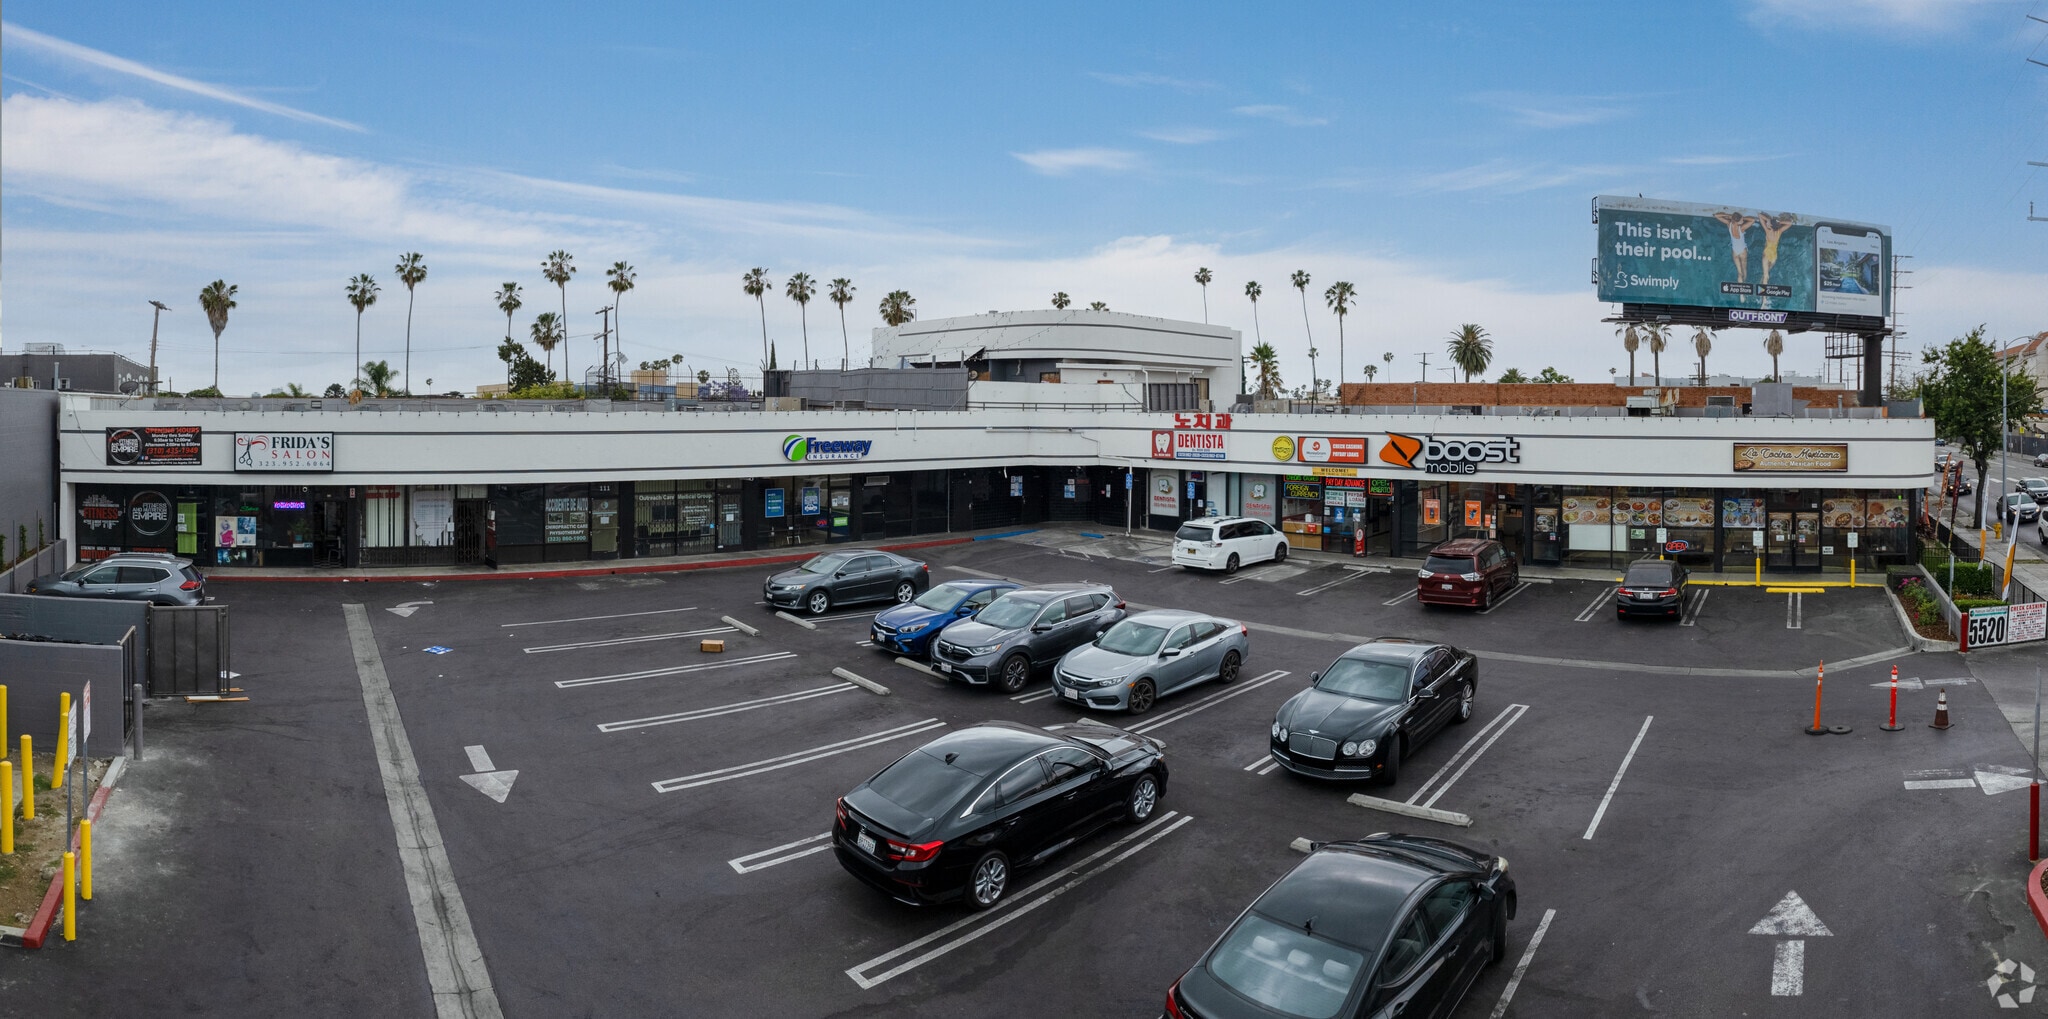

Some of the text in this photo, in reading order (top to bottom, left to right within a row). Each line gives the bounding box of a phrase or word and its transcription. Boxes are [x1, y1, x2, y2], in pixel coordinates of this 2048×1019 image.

[1615, 222, 1692, 240] This isn't
[1615, 242, 1712, 262] their pool...
[1630, 274, 1679, 290] Swimply
[1732, 311, 1783, 322] OUTFRONT
[1174, 413, 1232, 430] 노치과
[272, 436, 330, 449] FRIDA'S
[807, 437, 872, 455] Freeway
[1178, 434, 1224, 448] DENTISTA
[272, 450, 330, 459] SALON
[1425, 436, 1519, 462] boost
[1742, 448, 1840, 459] La Cocina Mexicana
[1426, 462, 1475, 473] mobile
[1345, 479, 1365, 487] ADVANCE
[1290, 490, 1318, 498] CURRENCY
[84, 507, 119, 520] FITNESS
[132, 512, 167, 520] EMPIRE
[1666, 542, 1687, 551] OPEN
[1969, 616, 2005, 645] 5520
